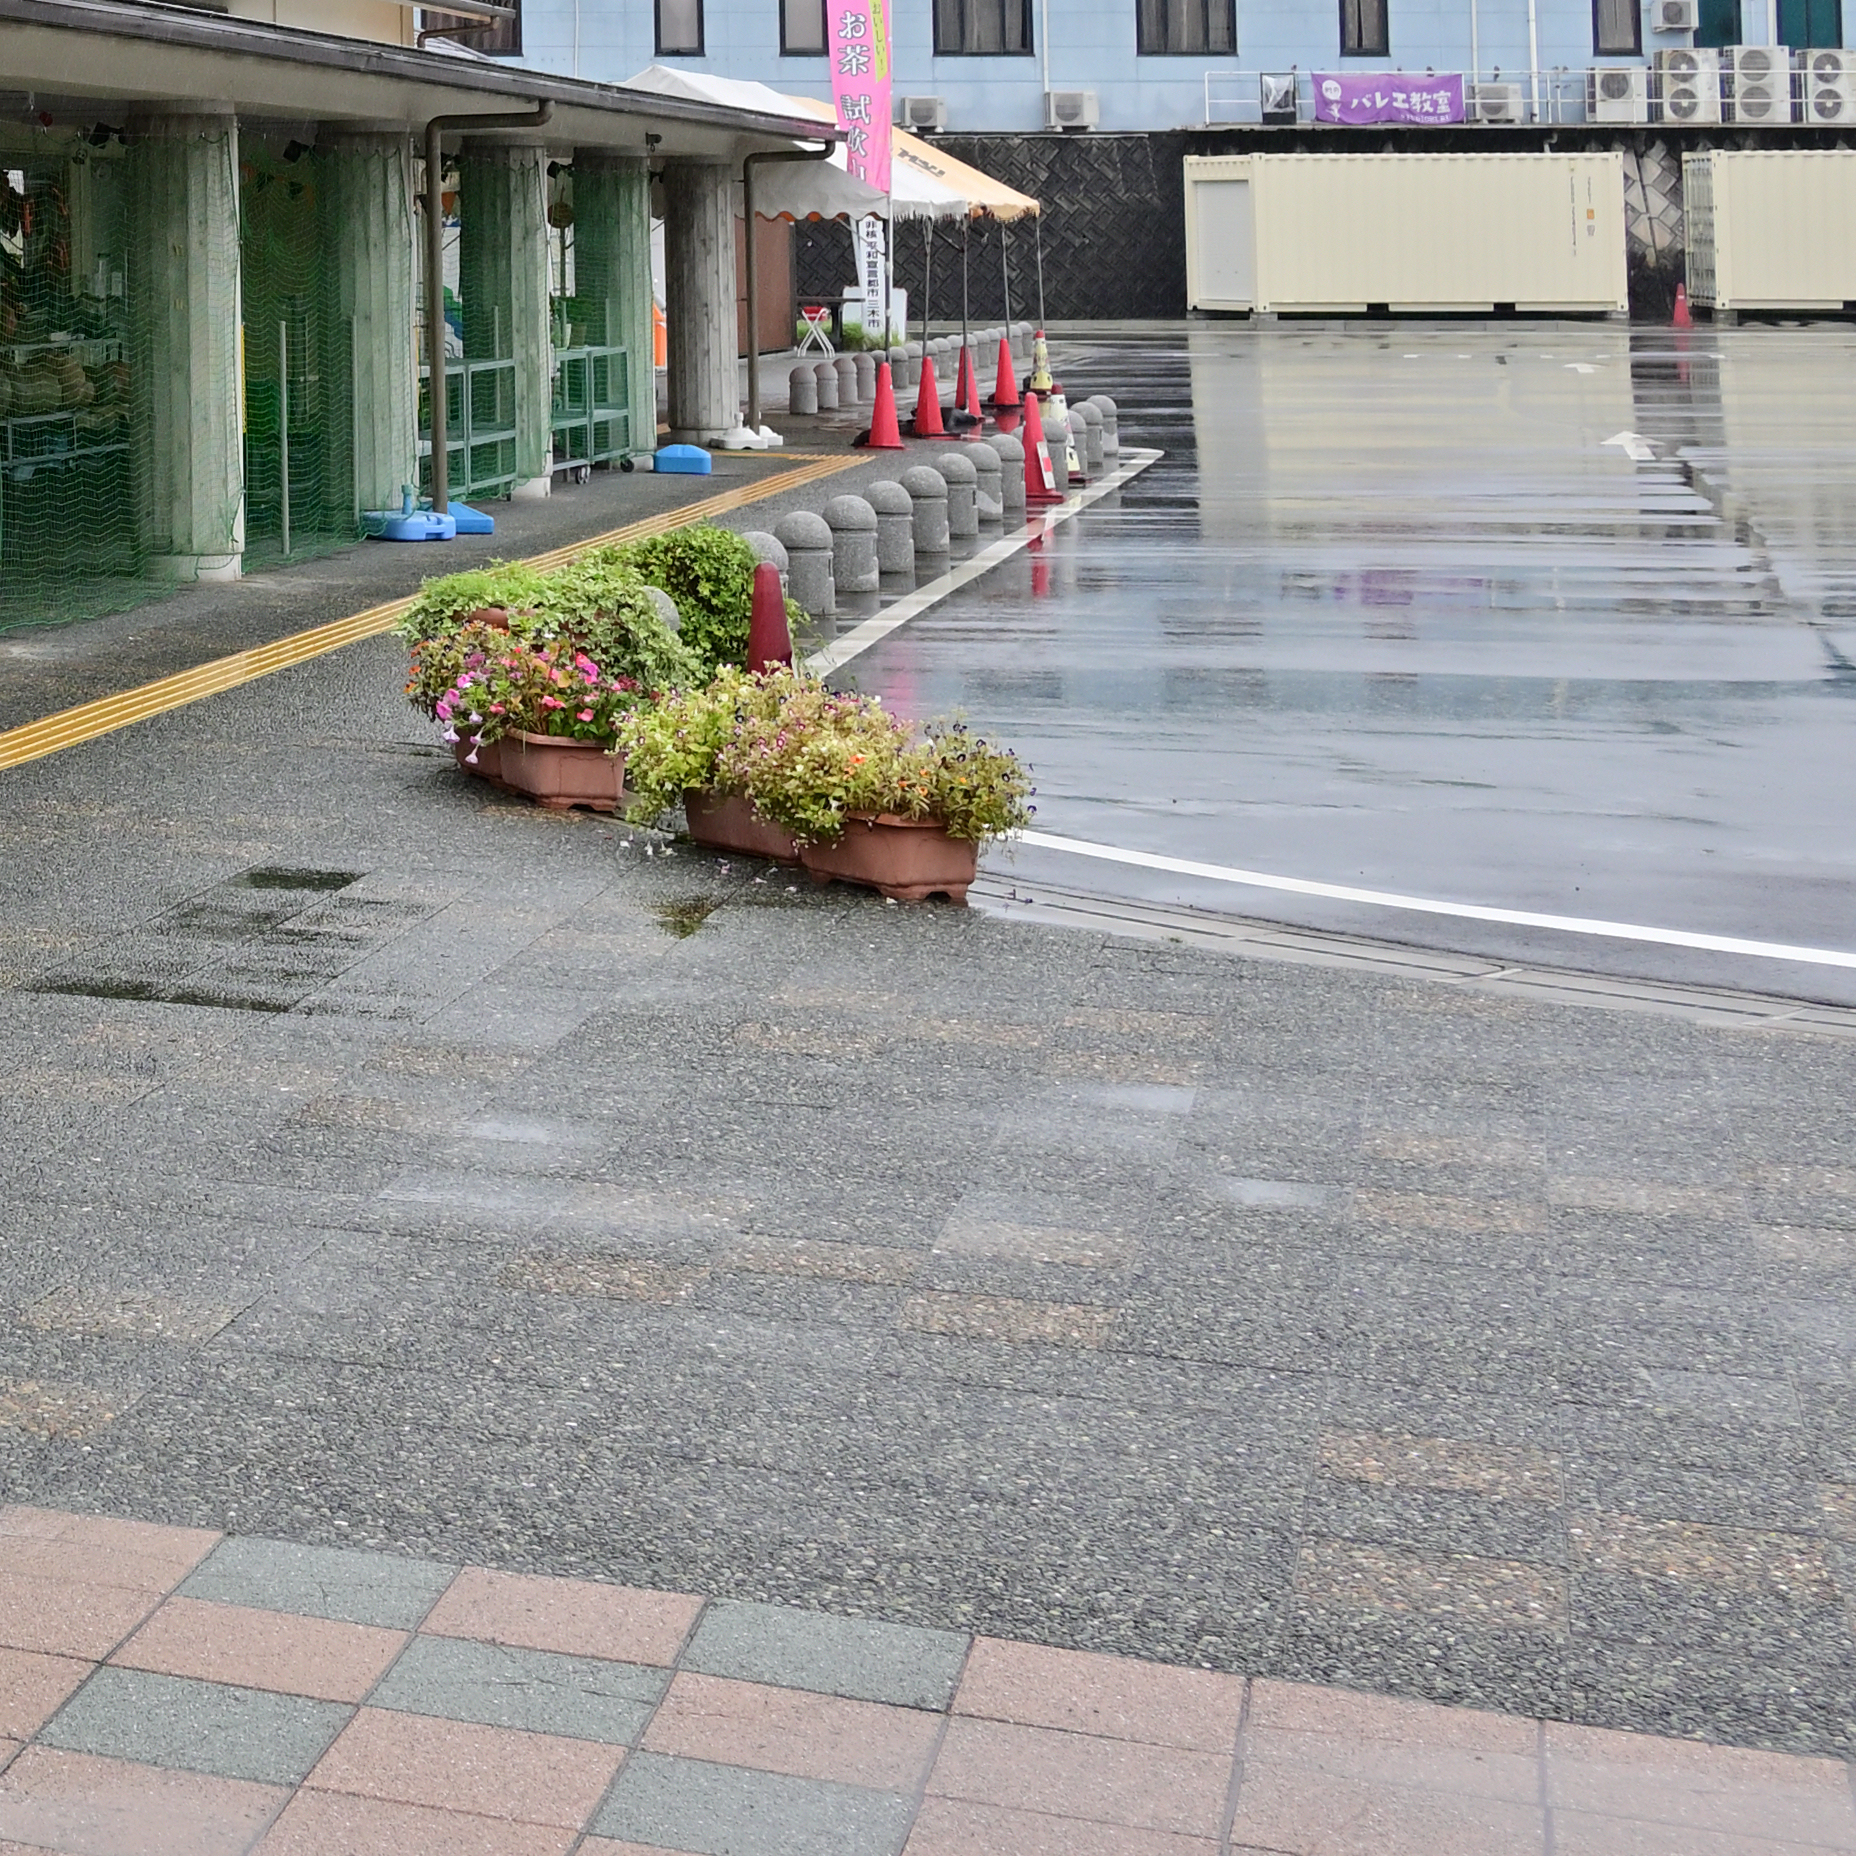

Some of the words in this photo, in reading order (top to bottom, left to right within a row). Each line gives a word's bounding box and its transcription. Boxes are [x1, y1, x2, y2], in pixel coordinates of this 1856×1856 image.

[838, 10, 870, 76] お茶
[1350, 90, 1452, 114] バレエ教室
